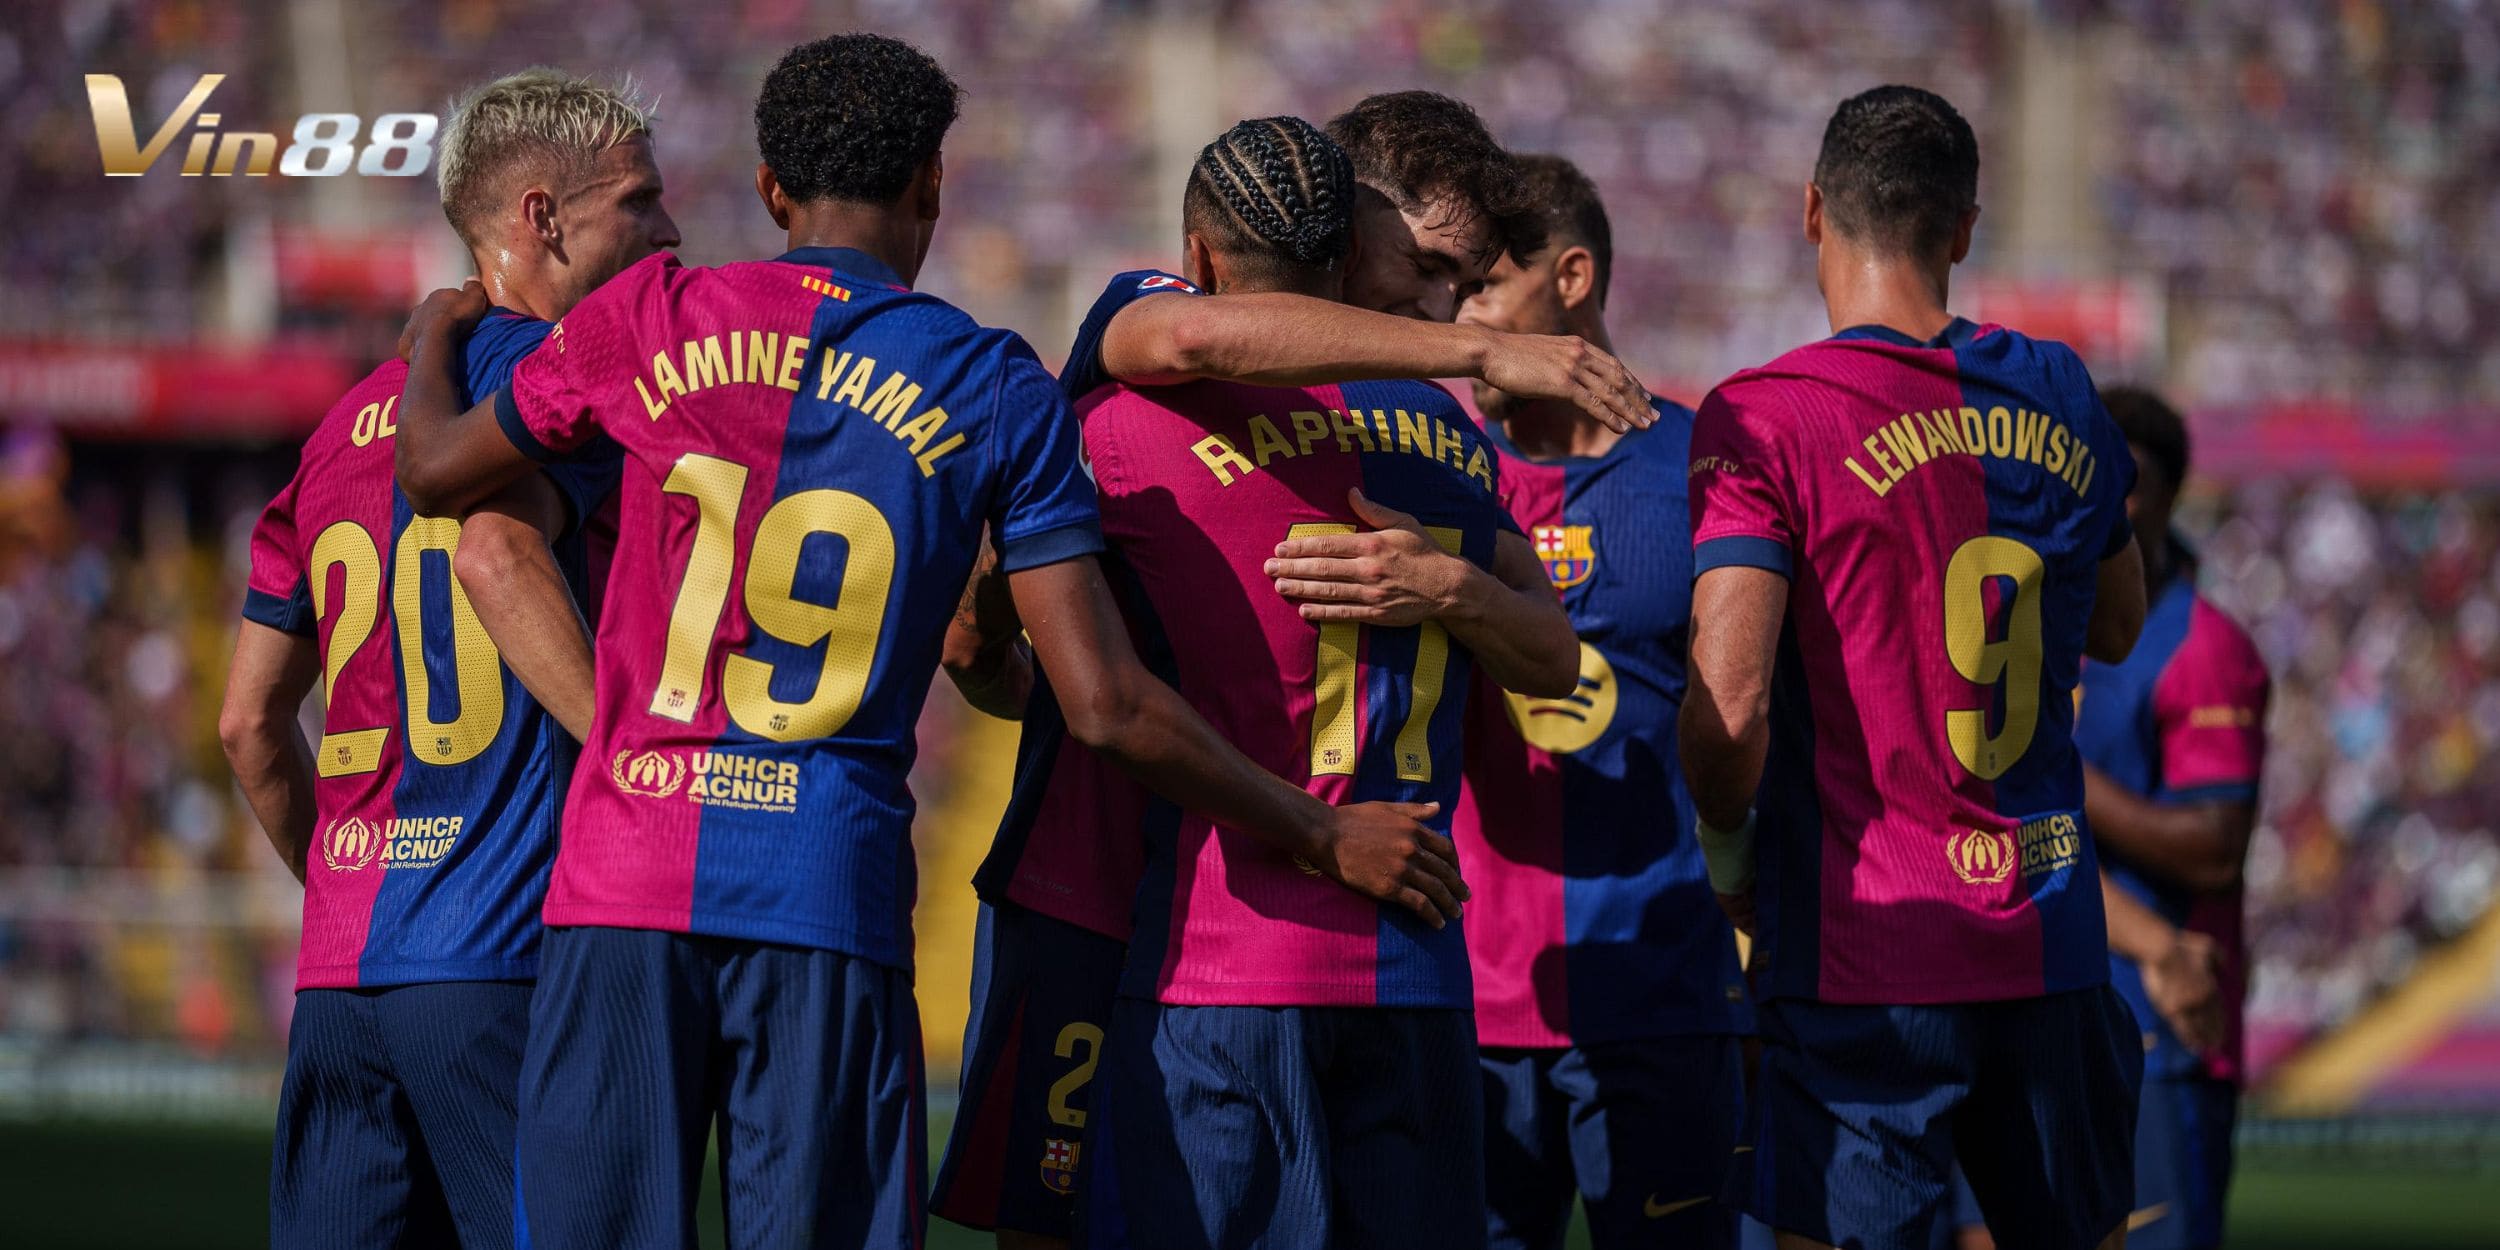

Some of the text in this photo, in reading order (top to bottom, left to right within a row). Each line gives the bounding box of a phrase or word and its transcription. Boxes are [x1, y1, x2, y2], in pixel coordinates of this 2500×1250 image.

[351, 395, 399, 447] OL
[634, 331, 968, 478] LAMINE YAMAL
[1190, 409, 1493, 491] RAPHINHA
[1844, 406, 2096, 498] LEWANDOWSKI
[648, 453, 896, 742] 19
[310, 513, 504, 779] 20
[1944, 536, 2045, 781] 9
[687, 775, 797, 804] ACNUR
[692, 752, 799, 786] UNHCR
[385, 816, 463, 840] UNHCR
[706, 797, 721, 806] UN
[722, 799, 760, 811] Refugee
[761, 803, 796, 814] Agency
[2016, 814, 2078, 848] UNHCR
[379, 836, 456, 861] ACNUR
[2020, 834, 2080, 871] ACNUR
[1048, 1022, 1104, 1128] 2
